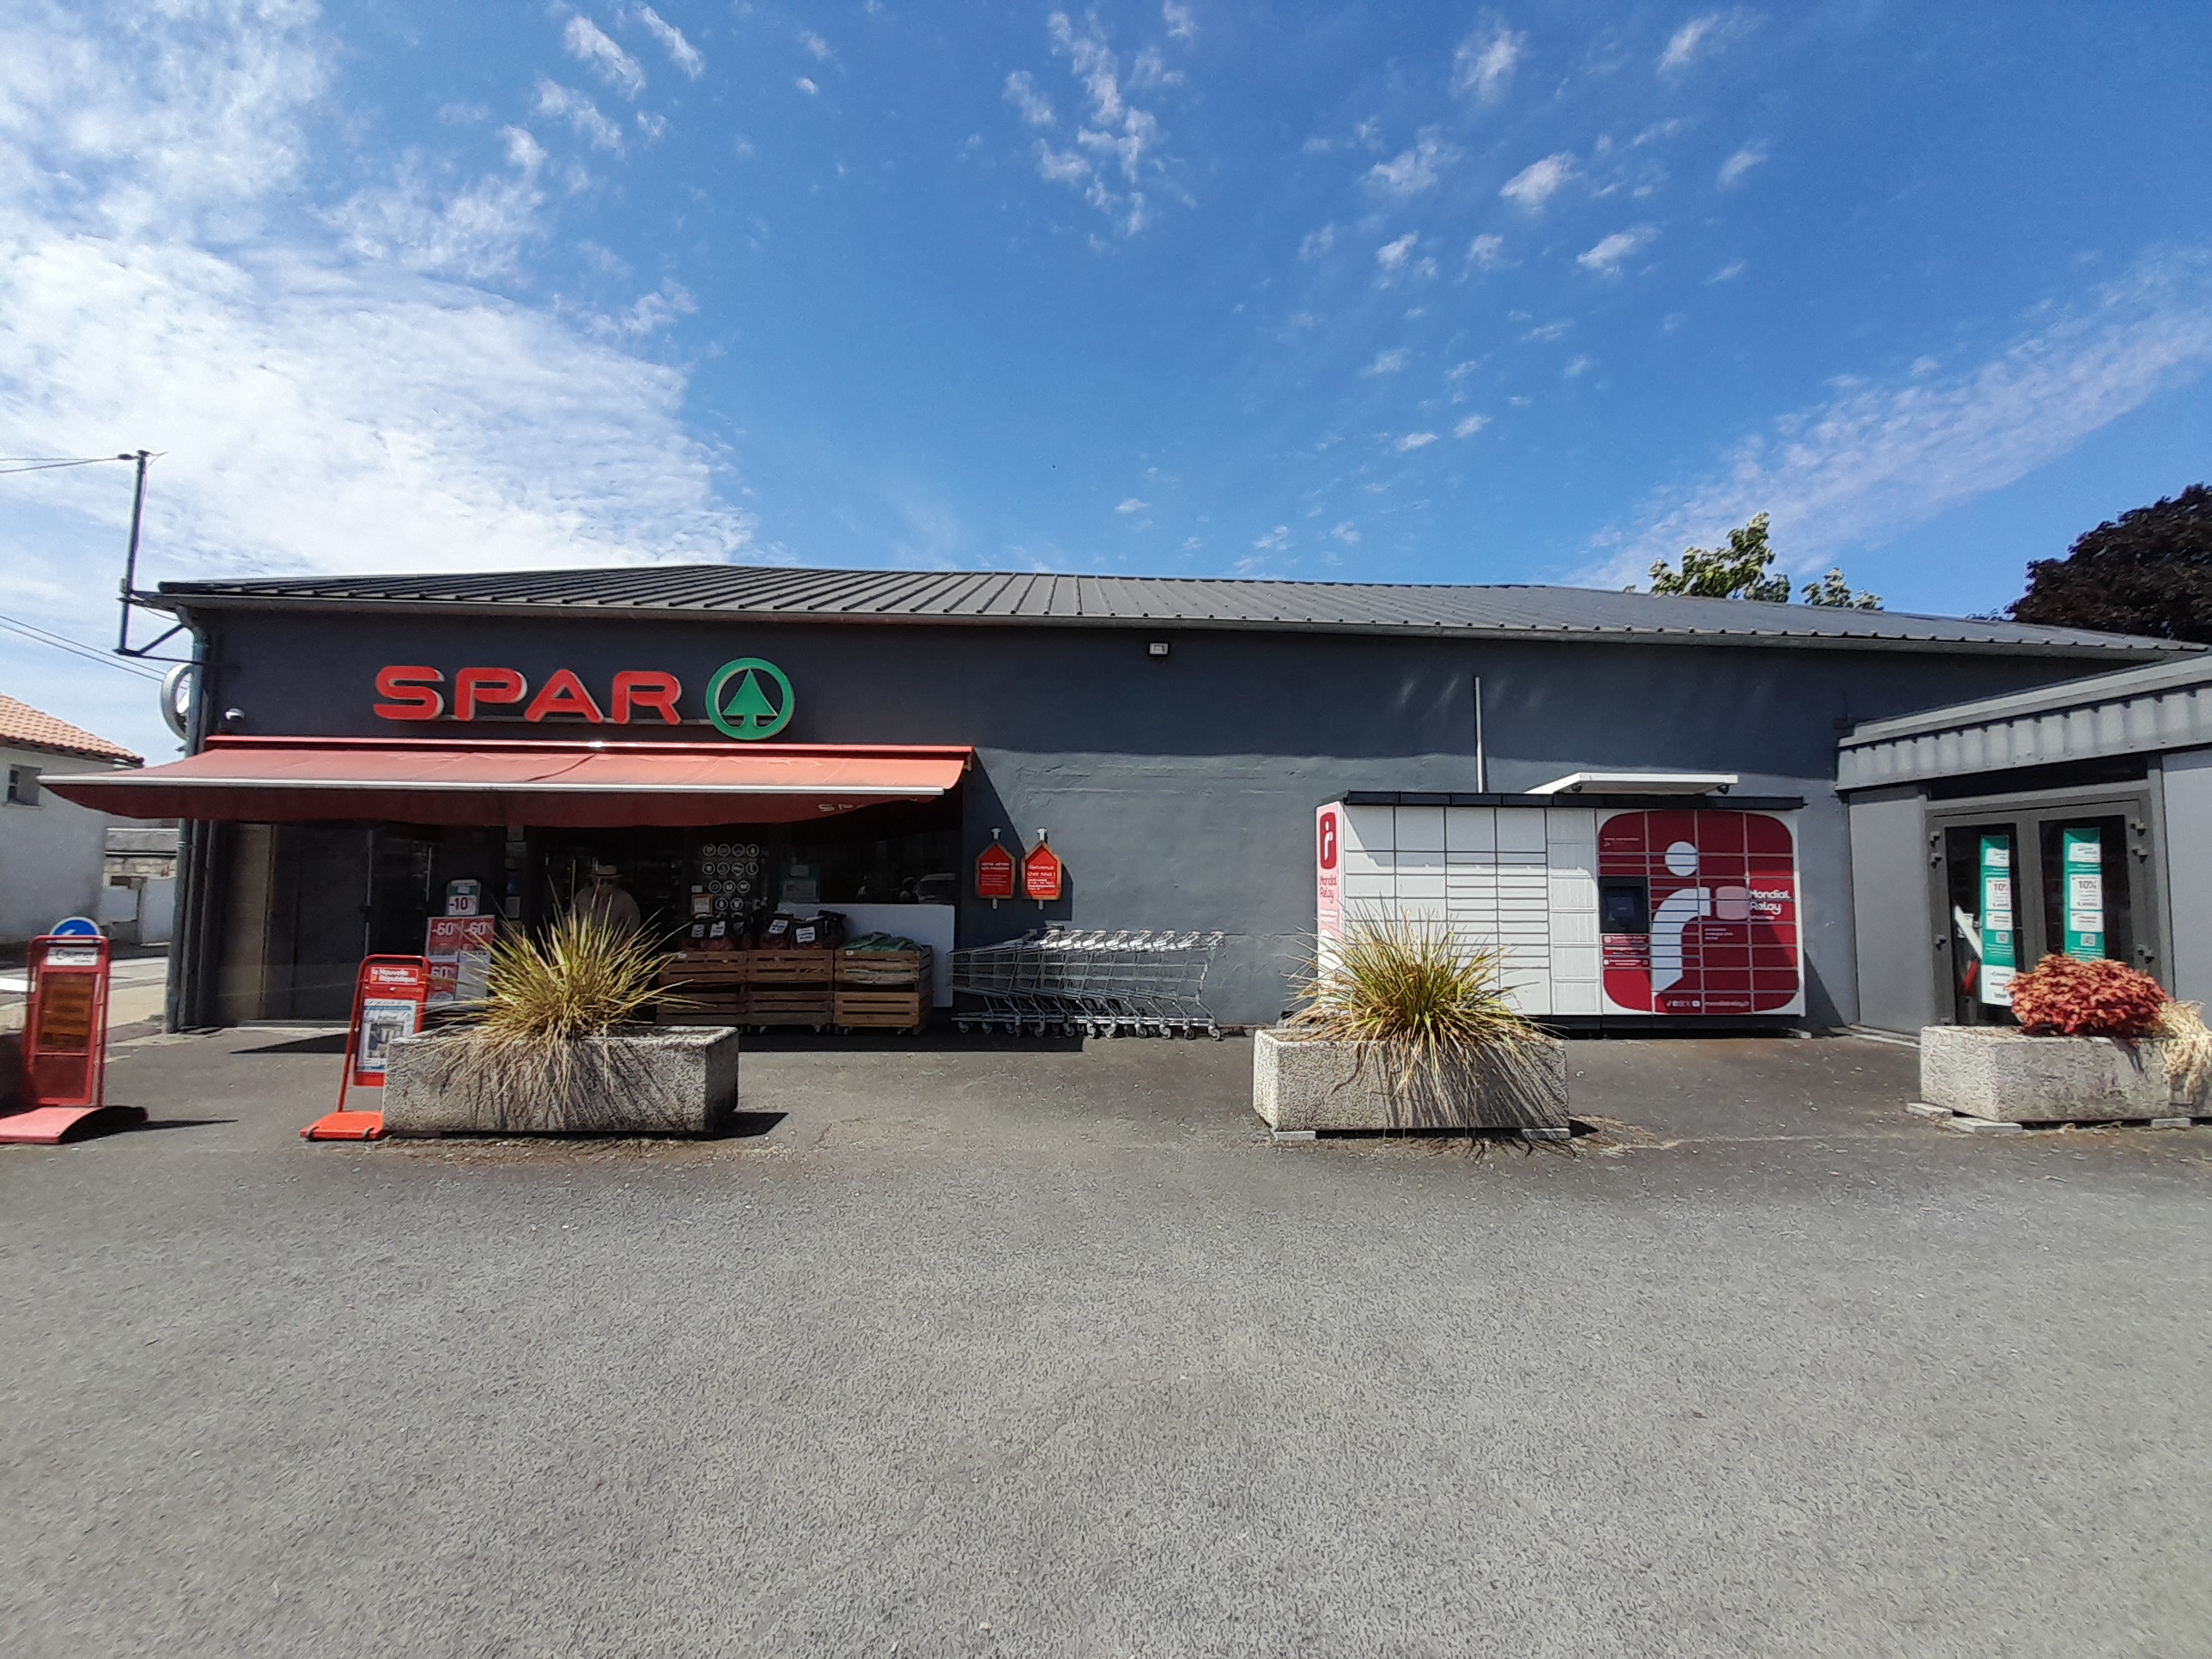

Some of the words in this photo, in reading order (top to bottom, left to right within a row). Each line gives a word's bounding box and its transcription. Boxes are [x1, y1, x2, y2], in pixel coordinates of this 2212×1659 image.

[374, 665, 684, 725] SPAR
[817, 804, 866, 812] SP
[1320, 875, 1337, 886] Mondial
[1320, 887, 1334, 903] Relay
[1749, 890, 1791, 899] Mondial
[1750, 902, 1782, 915] Relay
[380, 968, 409, 976] Nouvelle
[379, 975, 416, 984] République
